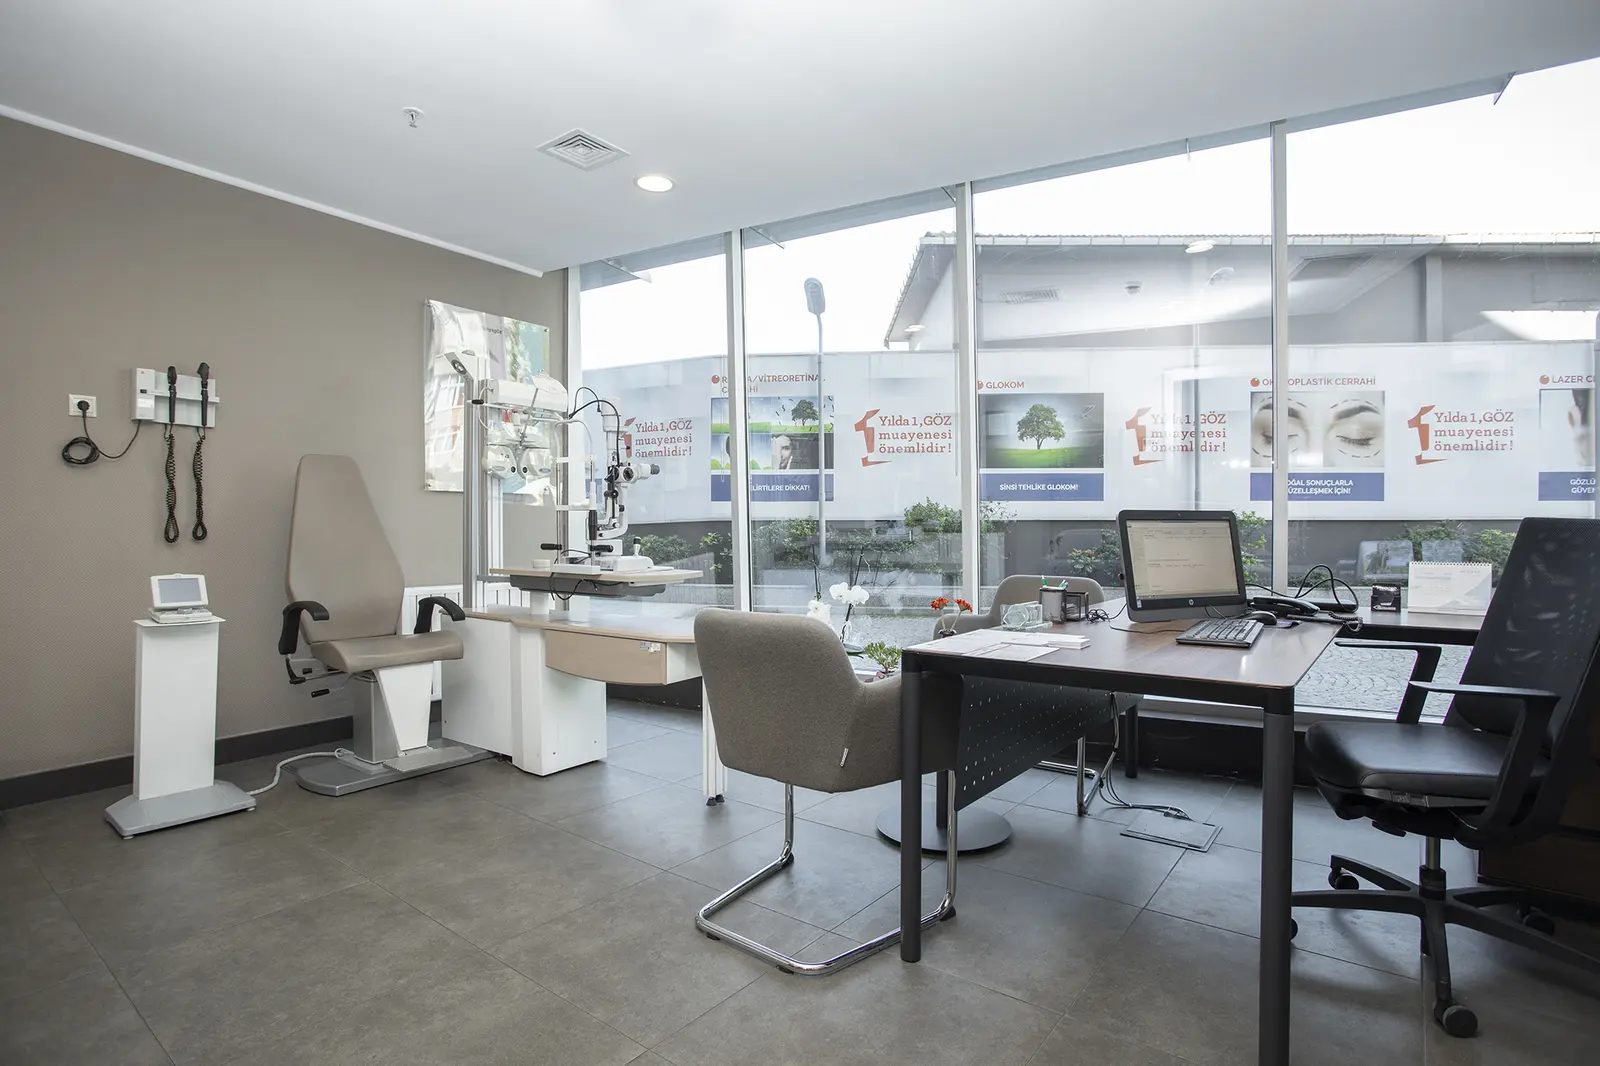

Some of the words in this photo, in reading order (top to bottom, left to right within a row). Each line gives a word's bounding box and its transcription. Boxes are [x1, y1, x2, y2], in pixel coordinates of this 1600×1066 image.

[1335, 375, 1376, 386] CERRAHİ
[1552, 375, 1584, 383] LAZER
[986, 381, 1025, 389] GLOKOM
[879, 415, 909, 426] Yılda
[1434, 411, 1466, 423] Yılda
[635, 421, 658, 433] Yılda
[879, 429, 952, 442] muayenesi
[1434, 427, 1514, 439] muayenesi
[635, 433, 692, 446] muayenesi
[1152, 441, 1226, 452] önemldir!
[785, 483, 810, 491] DİKKAT!
[999, 483, 1018, 491] SİNSİ
[1019, 483, 1046, 491] TEHLİKE
[1306, 479, 1353, 488] SONUÇLARLA
